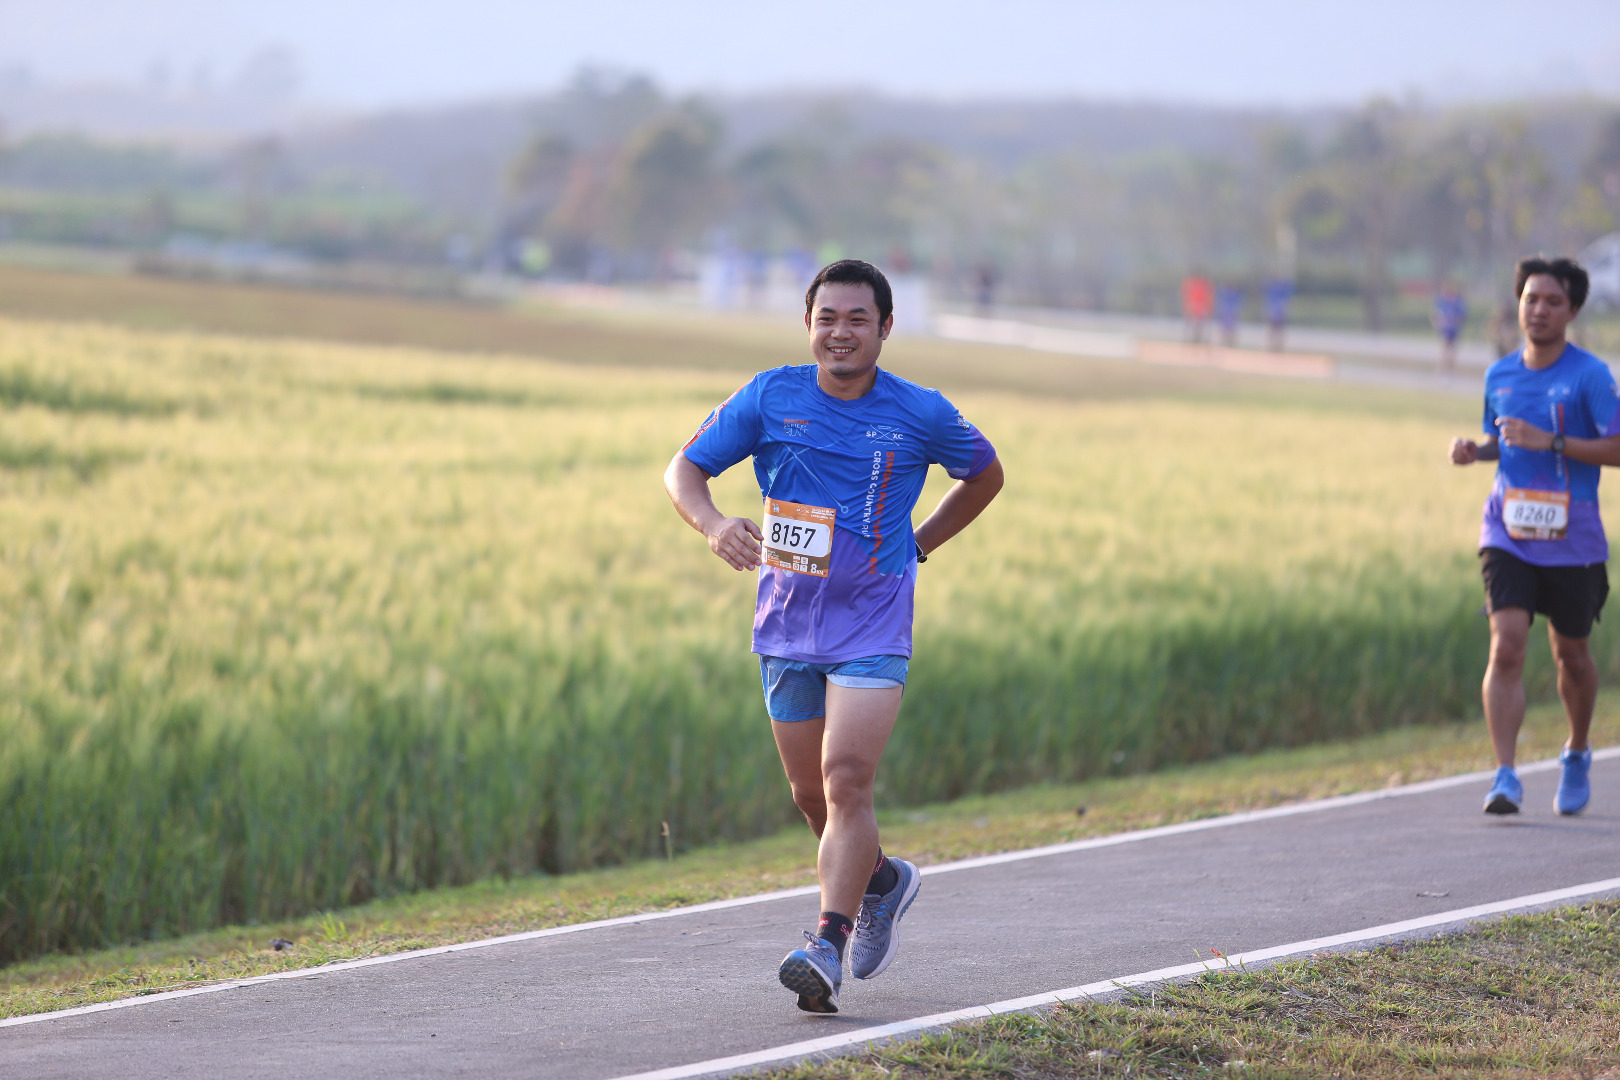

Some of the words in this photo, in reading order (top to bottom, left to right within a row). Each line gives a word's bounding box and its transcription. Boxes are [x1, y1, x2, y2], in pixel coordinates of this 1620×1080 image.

[892, 432, 904, 440] XC
[870, 450, 882, 481] CROSS
[880, 451, 896, 490] SINGHA
[862, 482, 878, 524] COUNTRY
[874, 491, 888, 517] PARK
[1514, 504, 1556, 525] 8260
[771, 522, 817, 549] 8157
[868, 556, 878, 574] RAI
